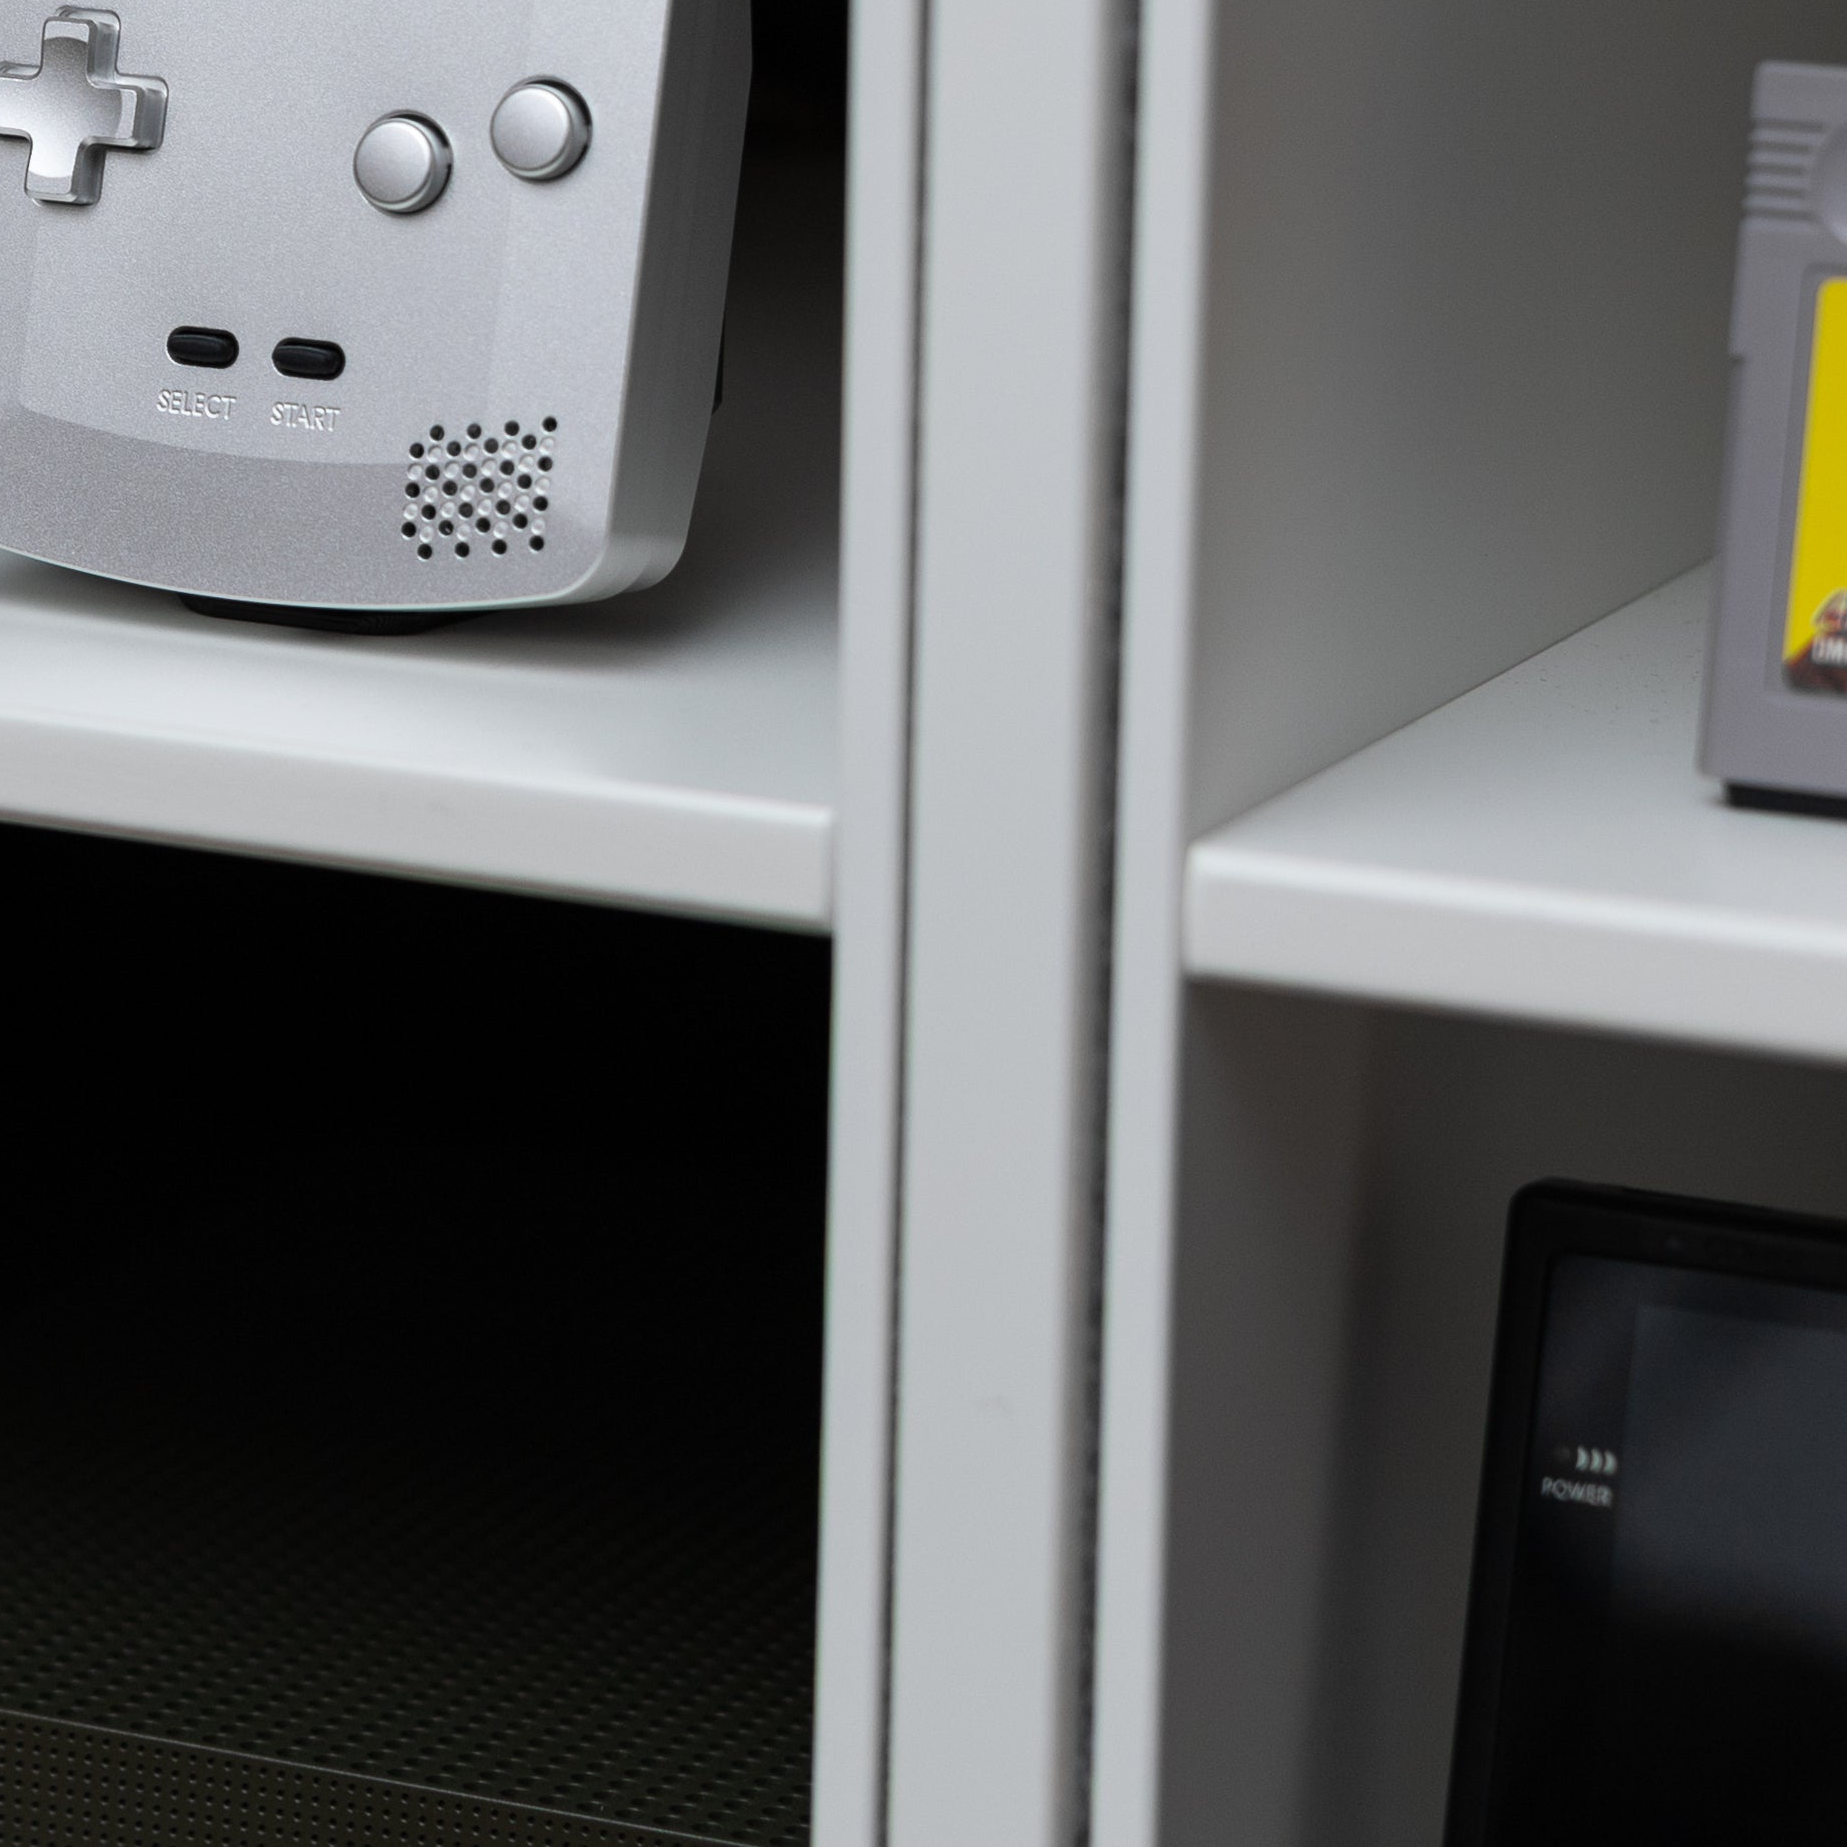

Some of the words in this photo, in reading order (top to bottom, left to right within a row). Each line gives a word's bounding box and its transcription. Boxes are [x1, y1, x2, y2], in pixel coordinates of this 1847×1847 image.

[156, 388, 237, 421] SELECT
[269, 401, 341, 433] START
[1541, 1476, 1613, 1508] POWER
